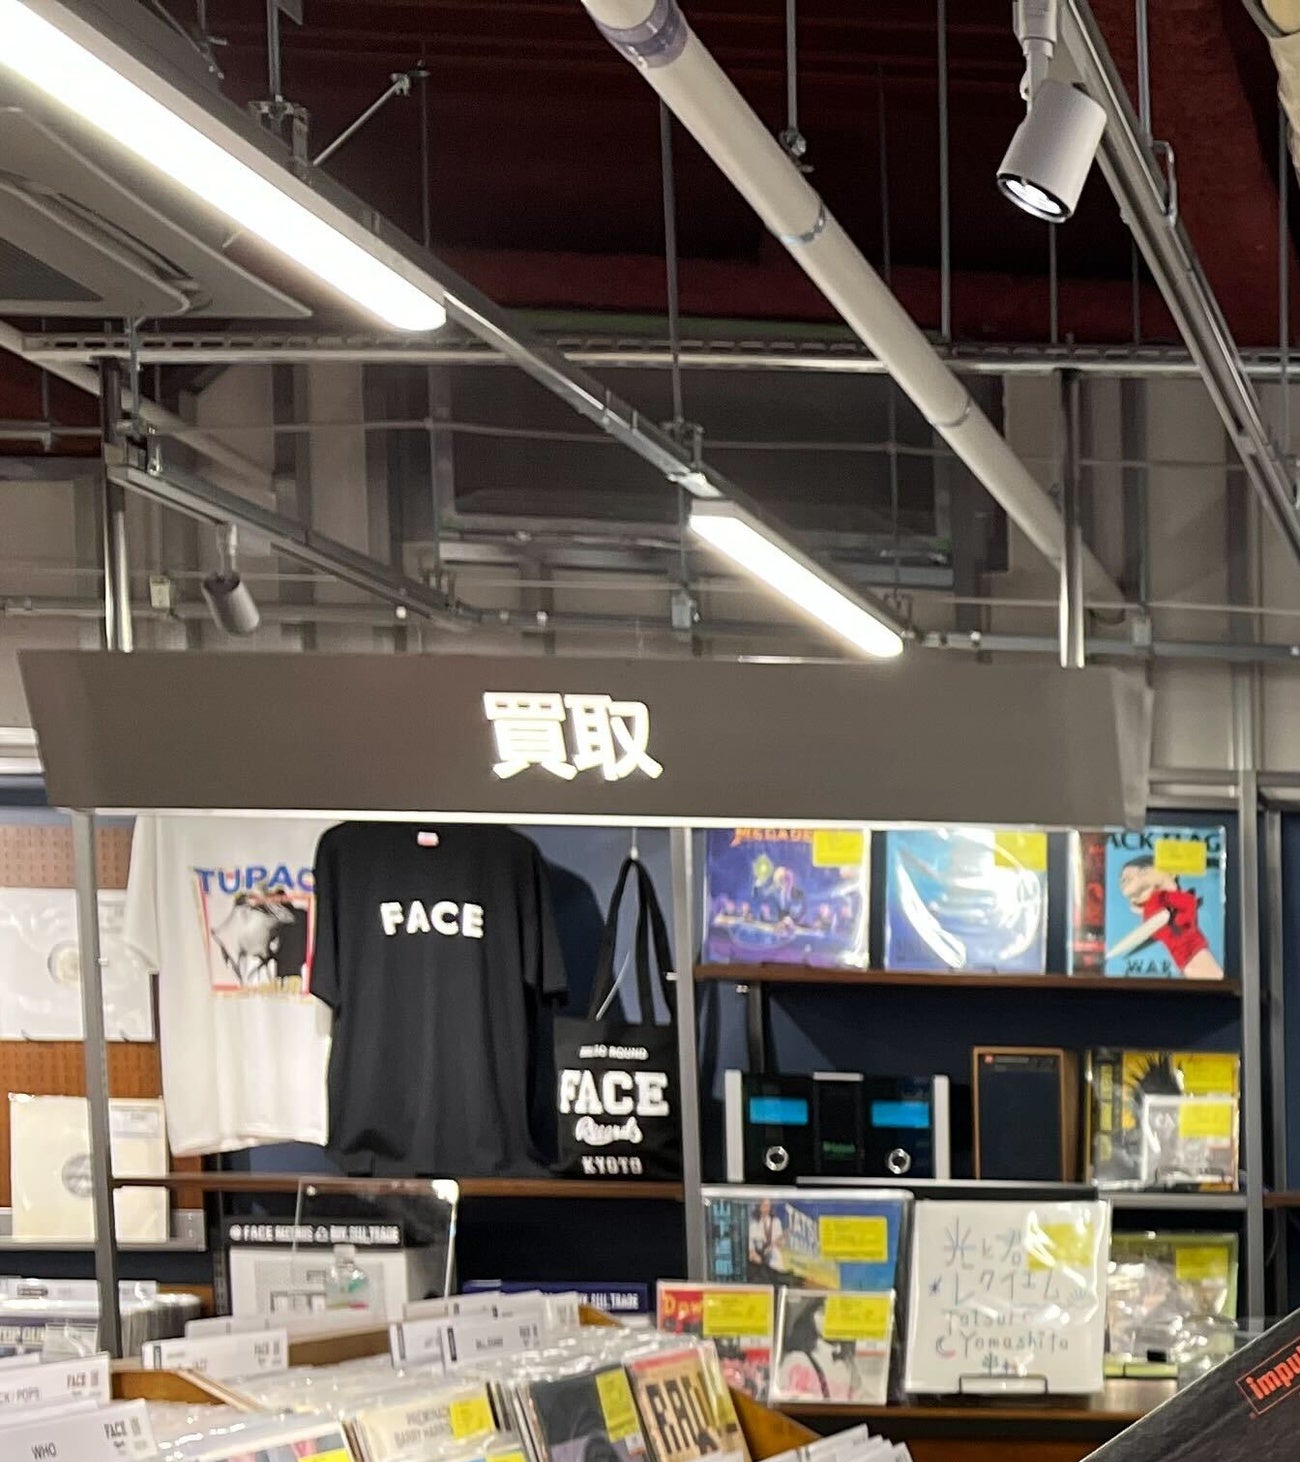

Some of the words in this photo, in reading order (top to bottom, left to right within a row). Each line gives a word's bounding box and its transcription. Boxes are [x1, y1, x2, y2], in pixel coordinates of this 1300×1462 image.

[484, 691, 663, 780] 買取
[380, 900, 484, 938] FACE
[560, 1069, 670, 1116] FACE
[31, 1442, 56, 1461] WHO
